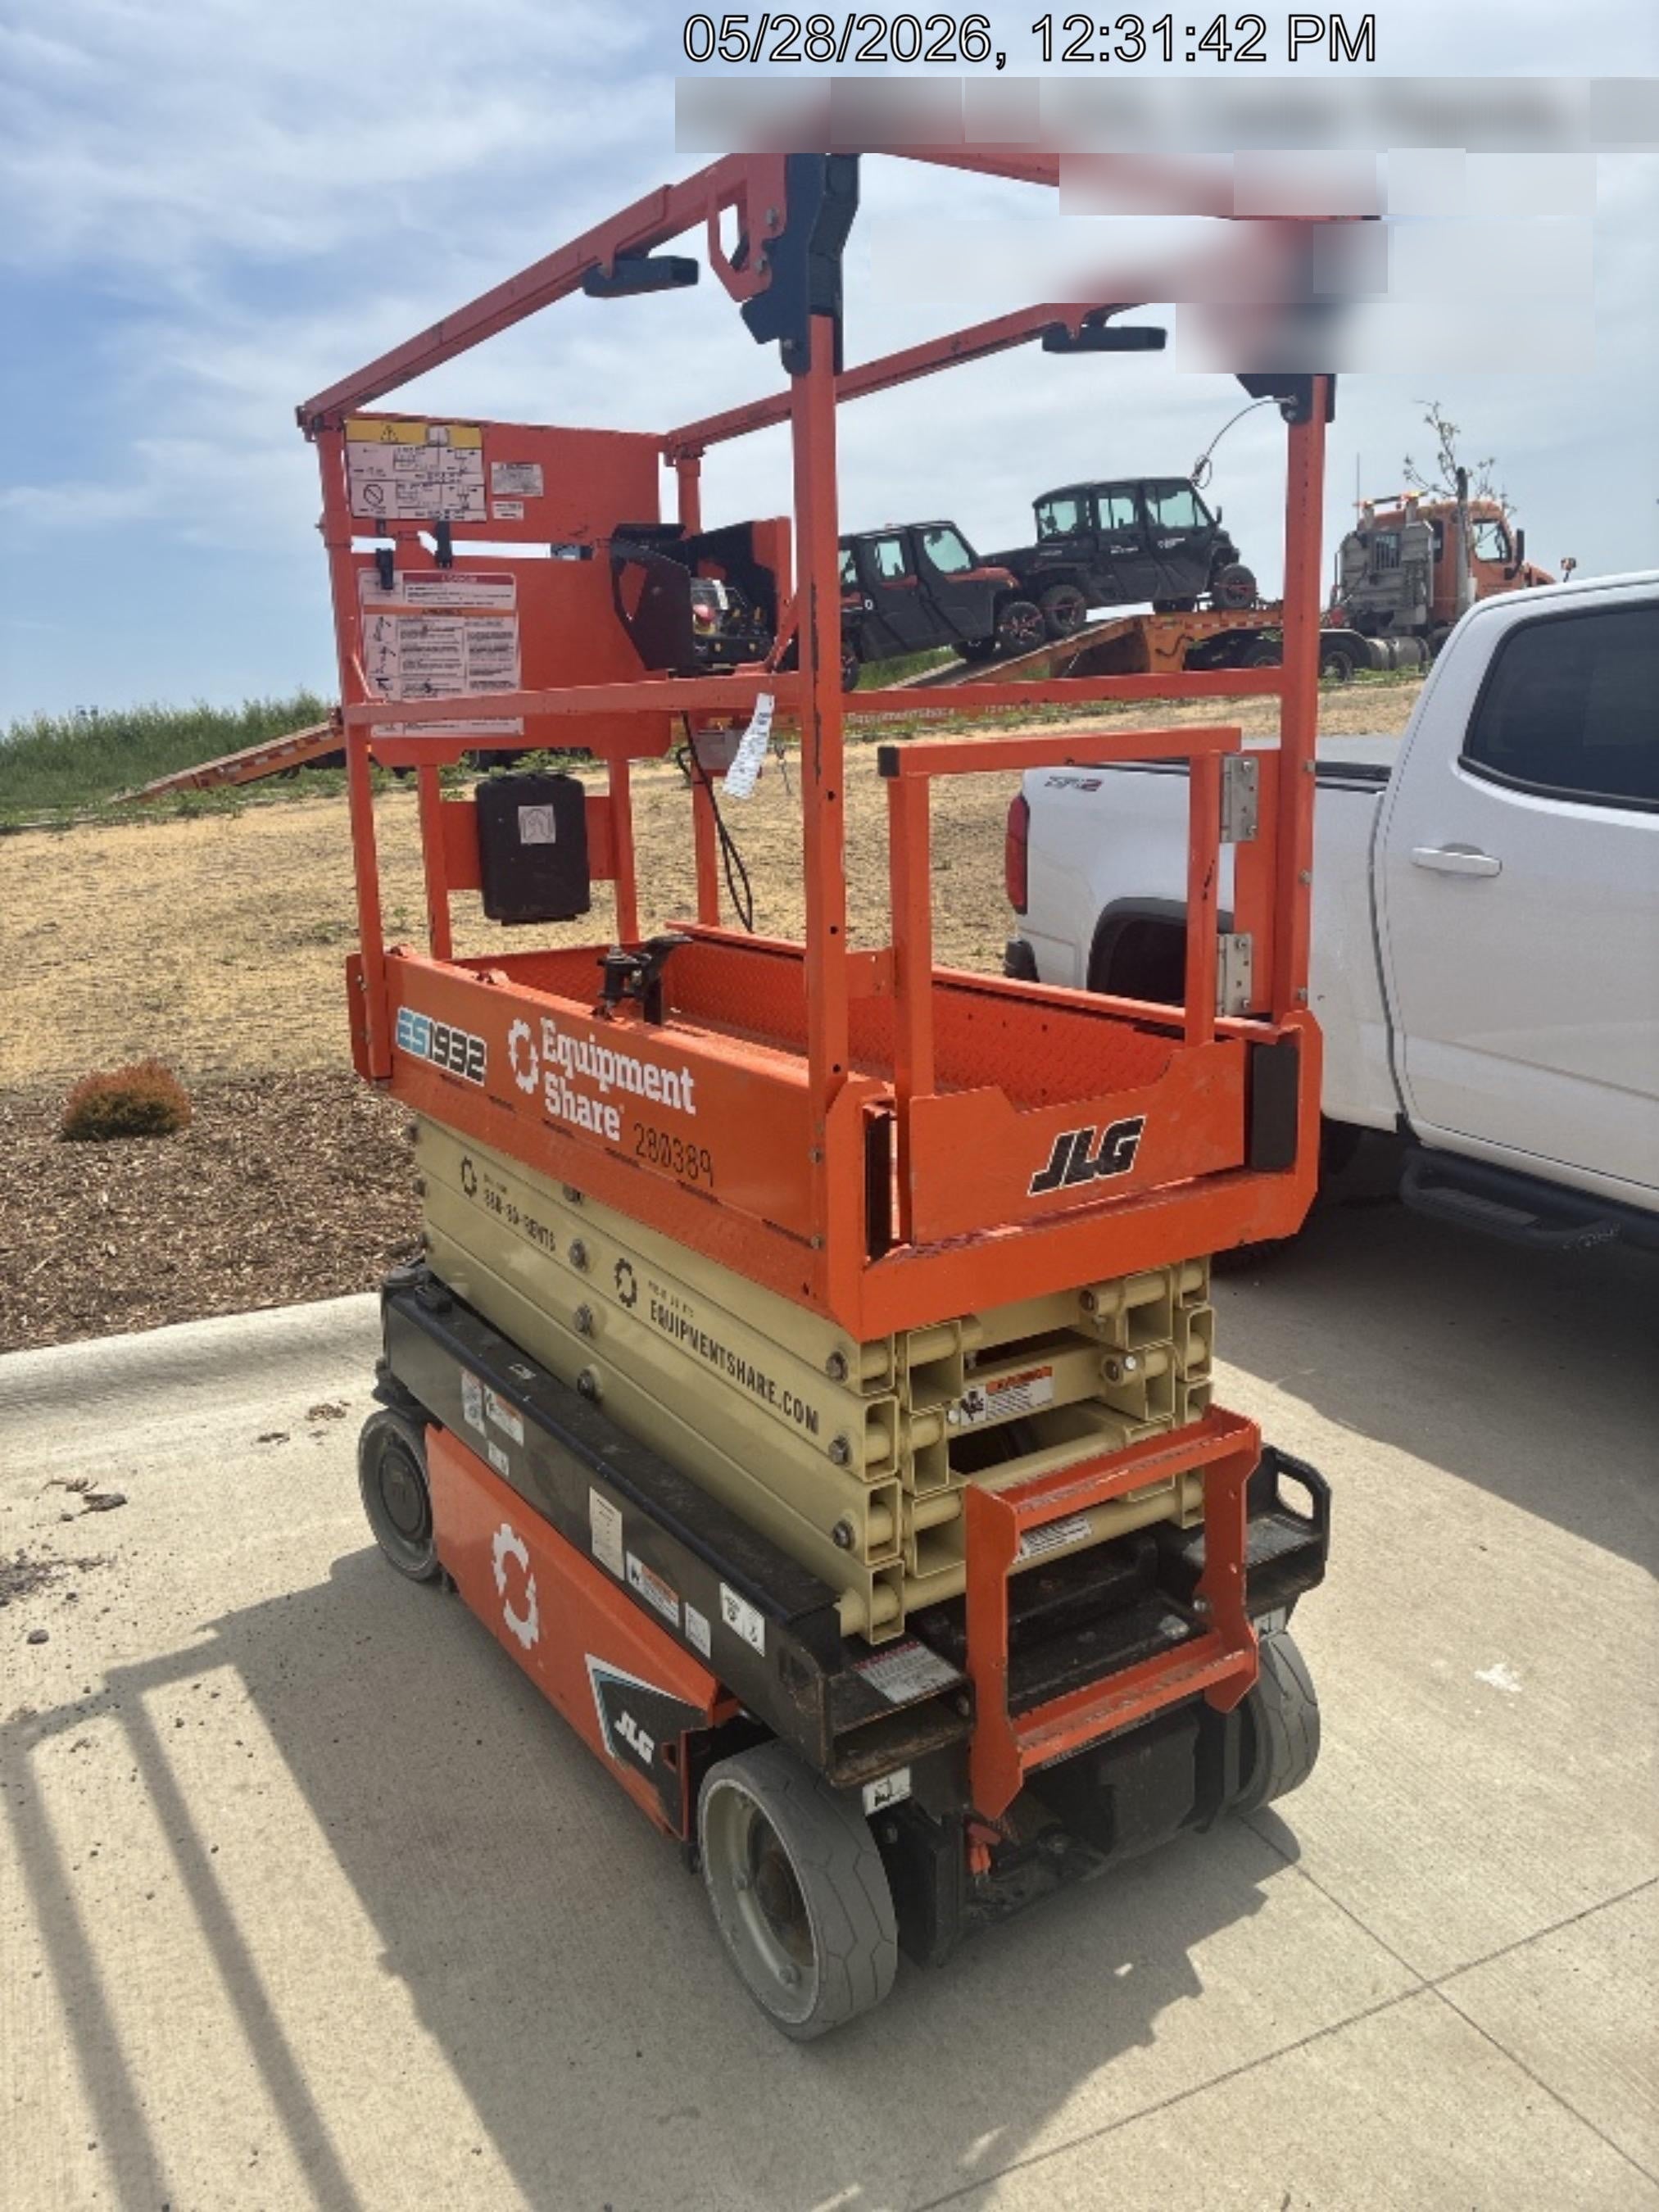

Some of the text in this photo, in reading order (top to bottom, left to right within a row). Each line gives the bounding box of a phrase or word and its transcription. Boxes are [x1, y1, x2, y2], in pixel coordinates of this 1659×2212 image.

[397, 1006, 487, 1087] ES1932
[540, 1017, 696, 1116] Equipment
[545, 1071, 621, 1141] Share
[634, 1122, 714, 1188] 280389
[1027, 1114, 1147, 1197] JLG
[650, 1299, 819, 1435] EQUIPMENTSHARE.COM
[614, 1711, 655, 1765] JLG
